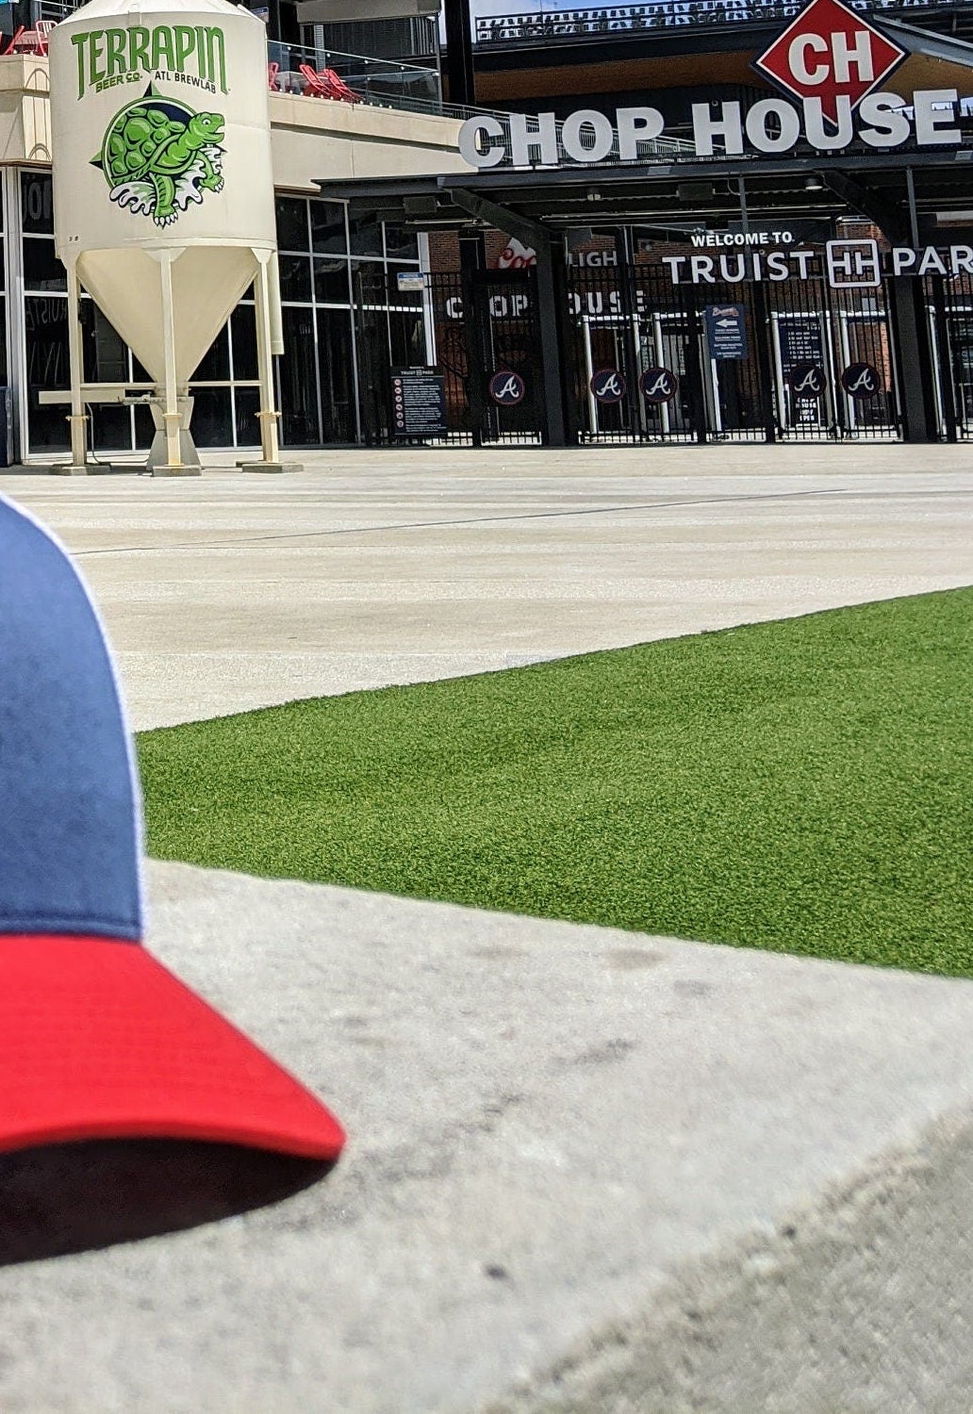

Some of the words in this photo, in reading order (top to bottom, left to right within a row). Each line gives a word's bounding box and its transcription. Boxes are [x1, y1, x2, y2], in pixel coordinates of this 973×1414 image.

[71, 25, 228, 100] TERRAPIN
[788, 30, 875, 87] CH
[96, 75, 124, 93] BEER
[154, 71, 171, 81] ATL
[174, 72, 216, 94] BREWLAB
[458, 107, 664, 168] CHOP
[692, 88, 963, 155] HOUSE
[691, 232, 769, 248] WELCOME
[568, 250, 617, 267] LIGH
[662, 250, 814, 284] TRUIST
